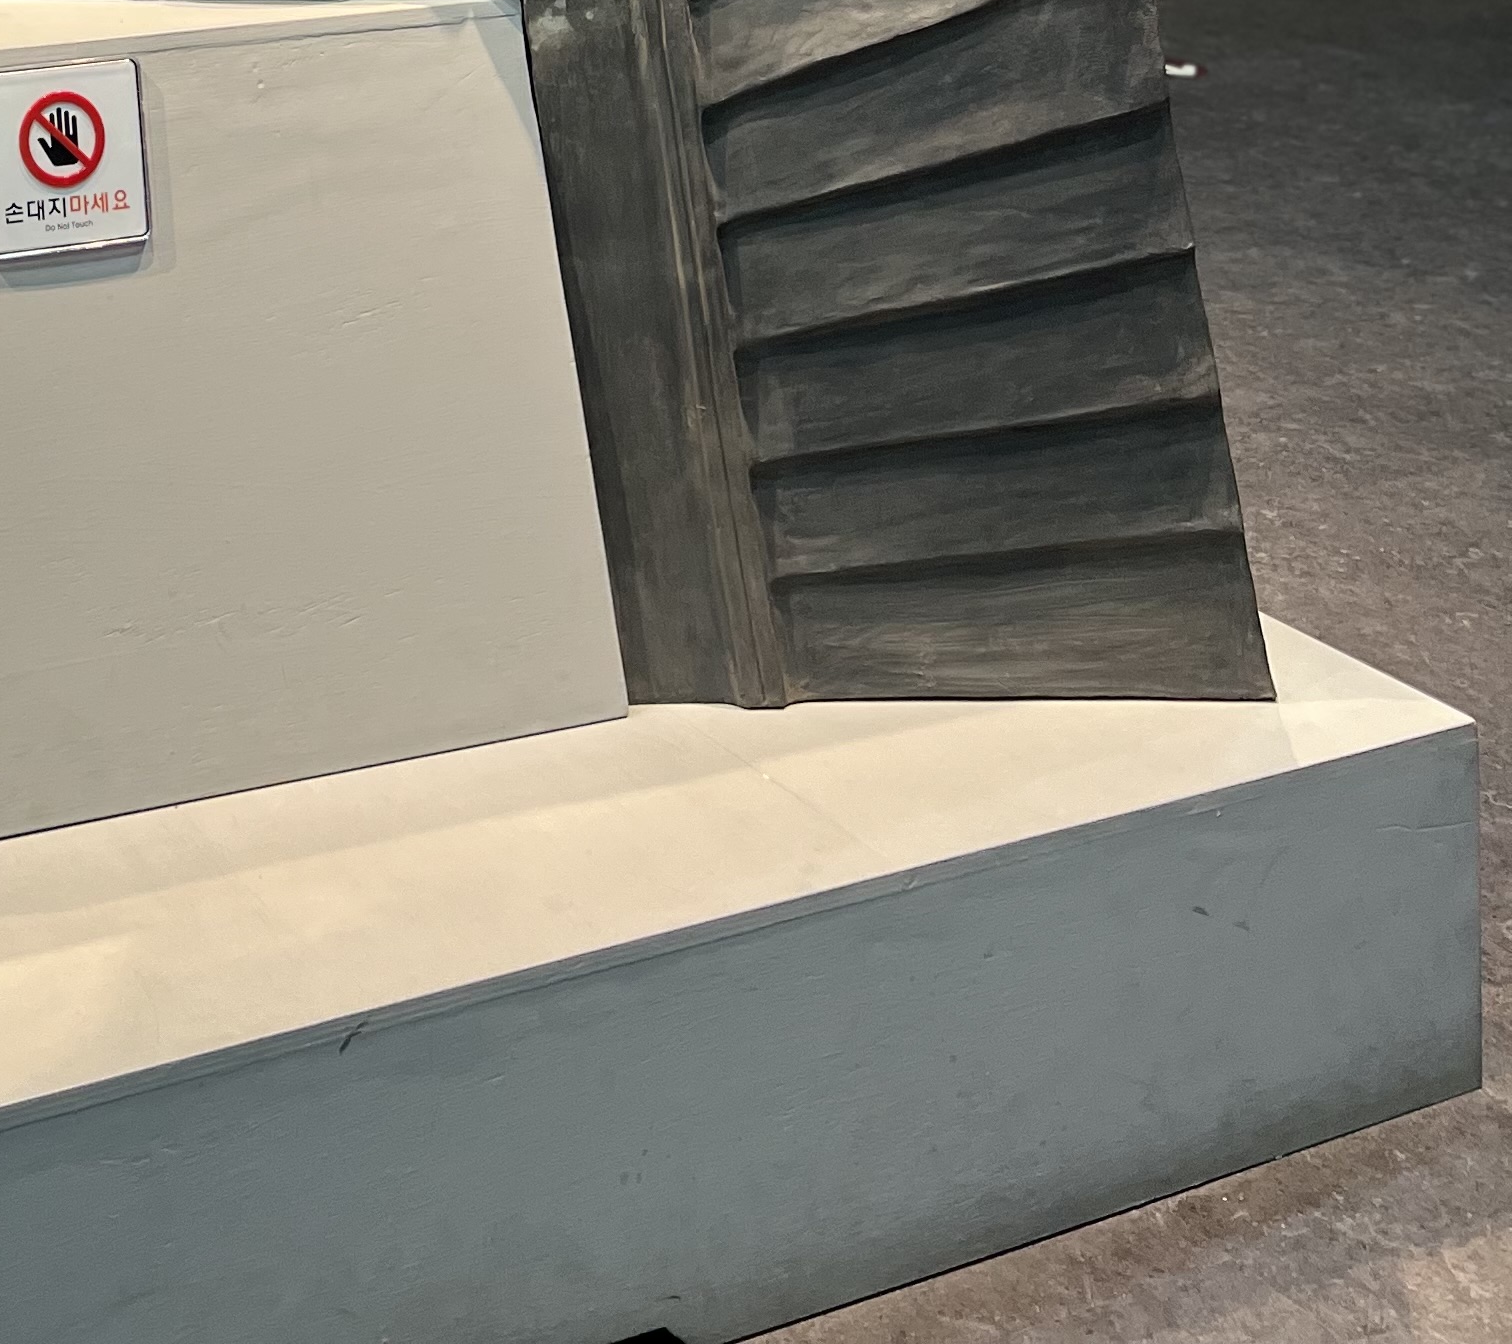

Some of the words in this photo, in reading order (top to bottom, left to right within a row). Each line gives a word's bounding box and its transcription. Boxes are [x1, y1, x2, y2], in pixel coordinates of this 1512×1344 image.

[4, 189, 131, 225] 손대지마세요
[45, 224, 56, 232] Do
[57, 221, 70, 231] Not
[71, 219, 94, 229] Touch
